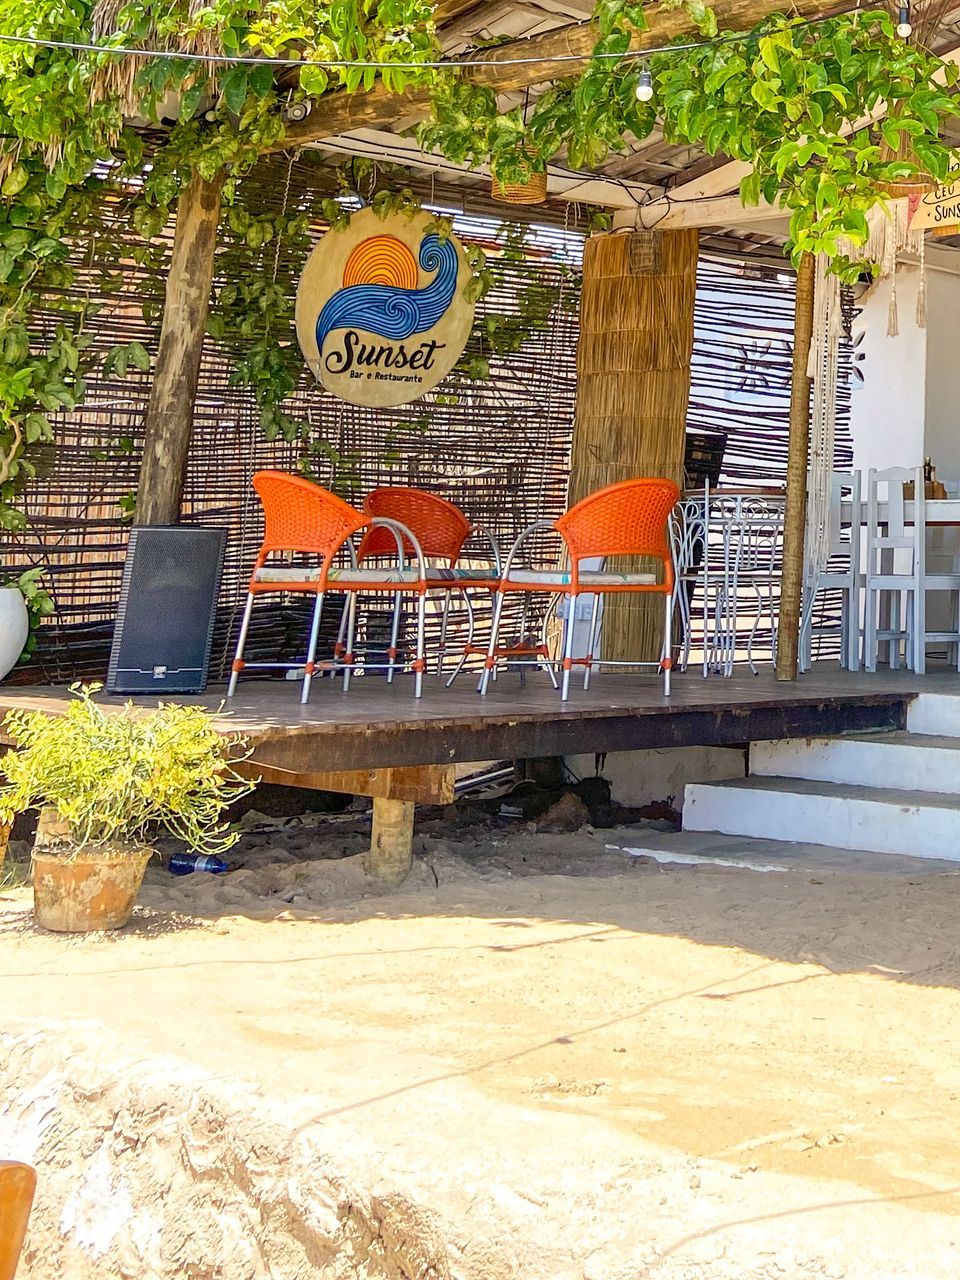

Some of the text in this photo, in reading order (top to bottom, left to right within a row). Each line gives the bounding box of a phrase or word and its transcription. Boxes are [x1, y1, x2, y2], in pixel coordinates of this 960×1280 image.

[325, 330, 447, 374] Sunset
[350, 370, 423, 383] Bar e Restaurante
